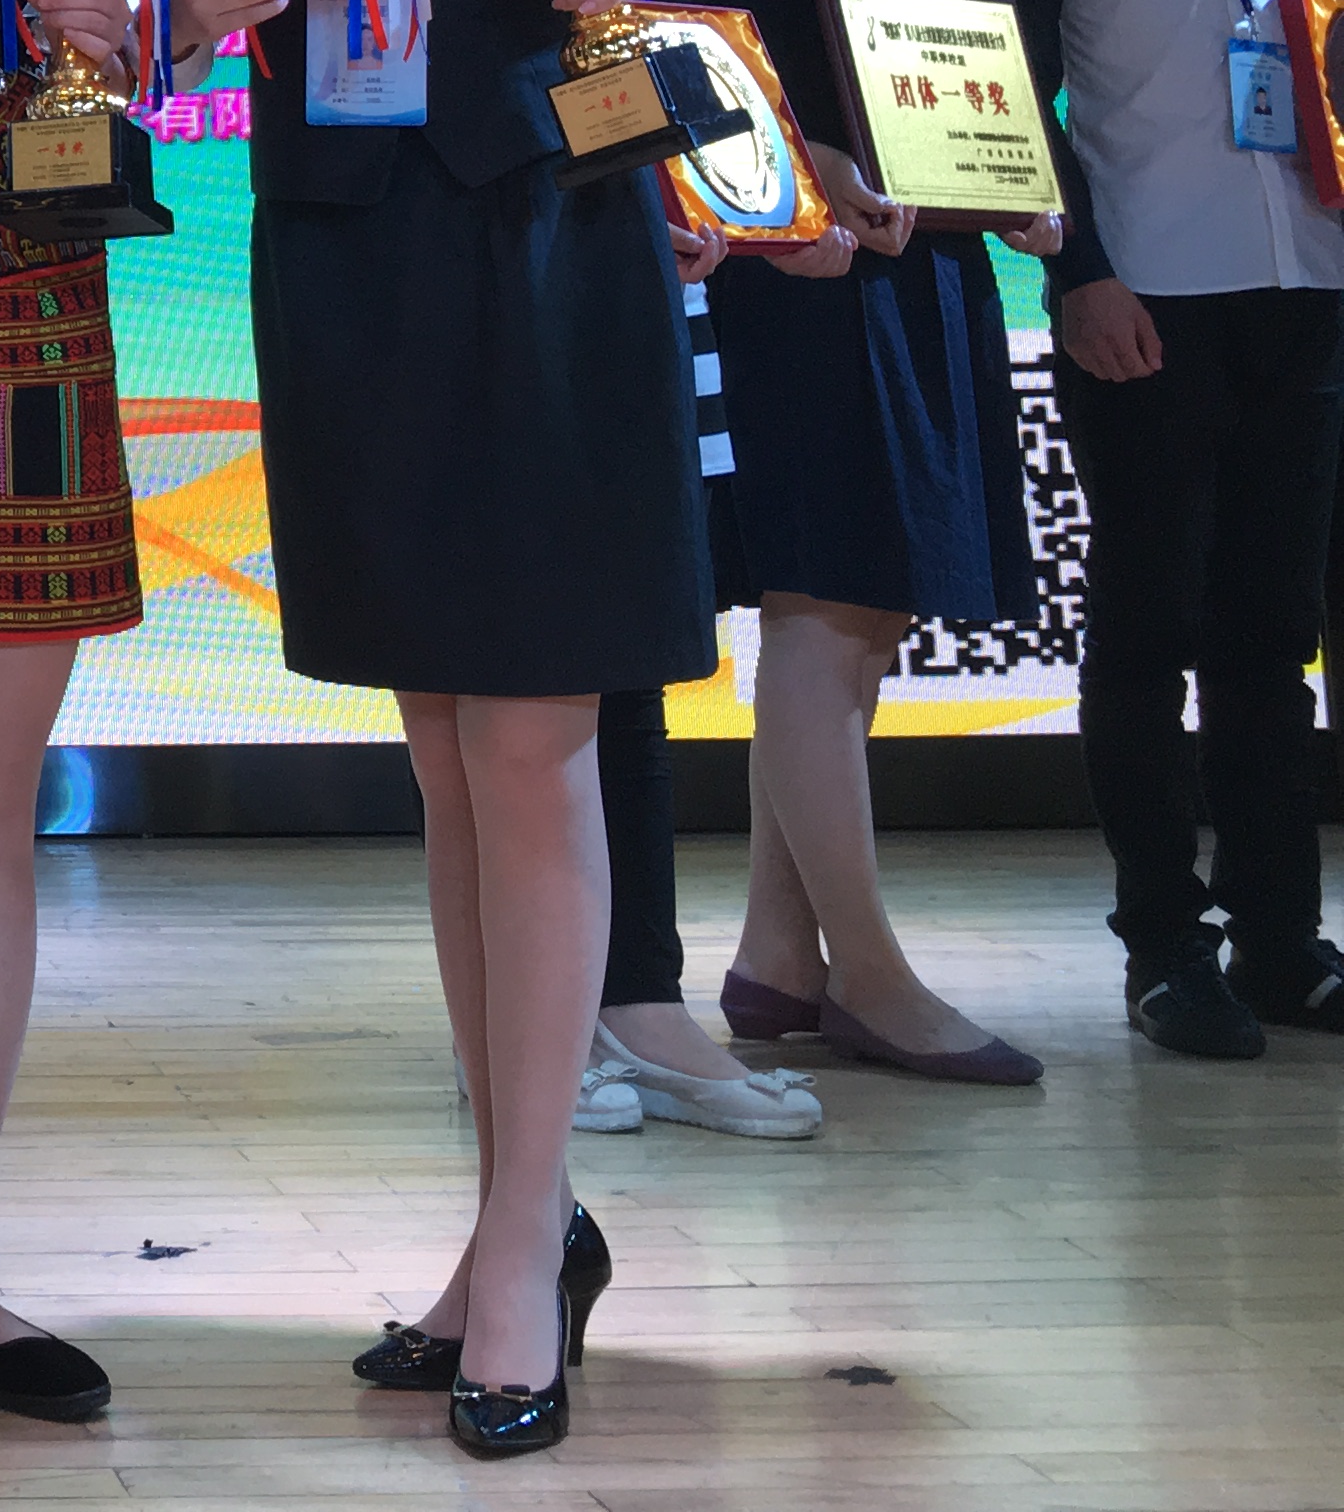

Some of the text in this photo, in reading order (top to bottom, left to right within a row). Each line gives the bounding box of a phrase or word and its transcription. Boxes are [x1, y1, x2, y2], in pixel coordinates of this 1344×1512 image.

[890, 73, 1010, 116] 团体一等奖
